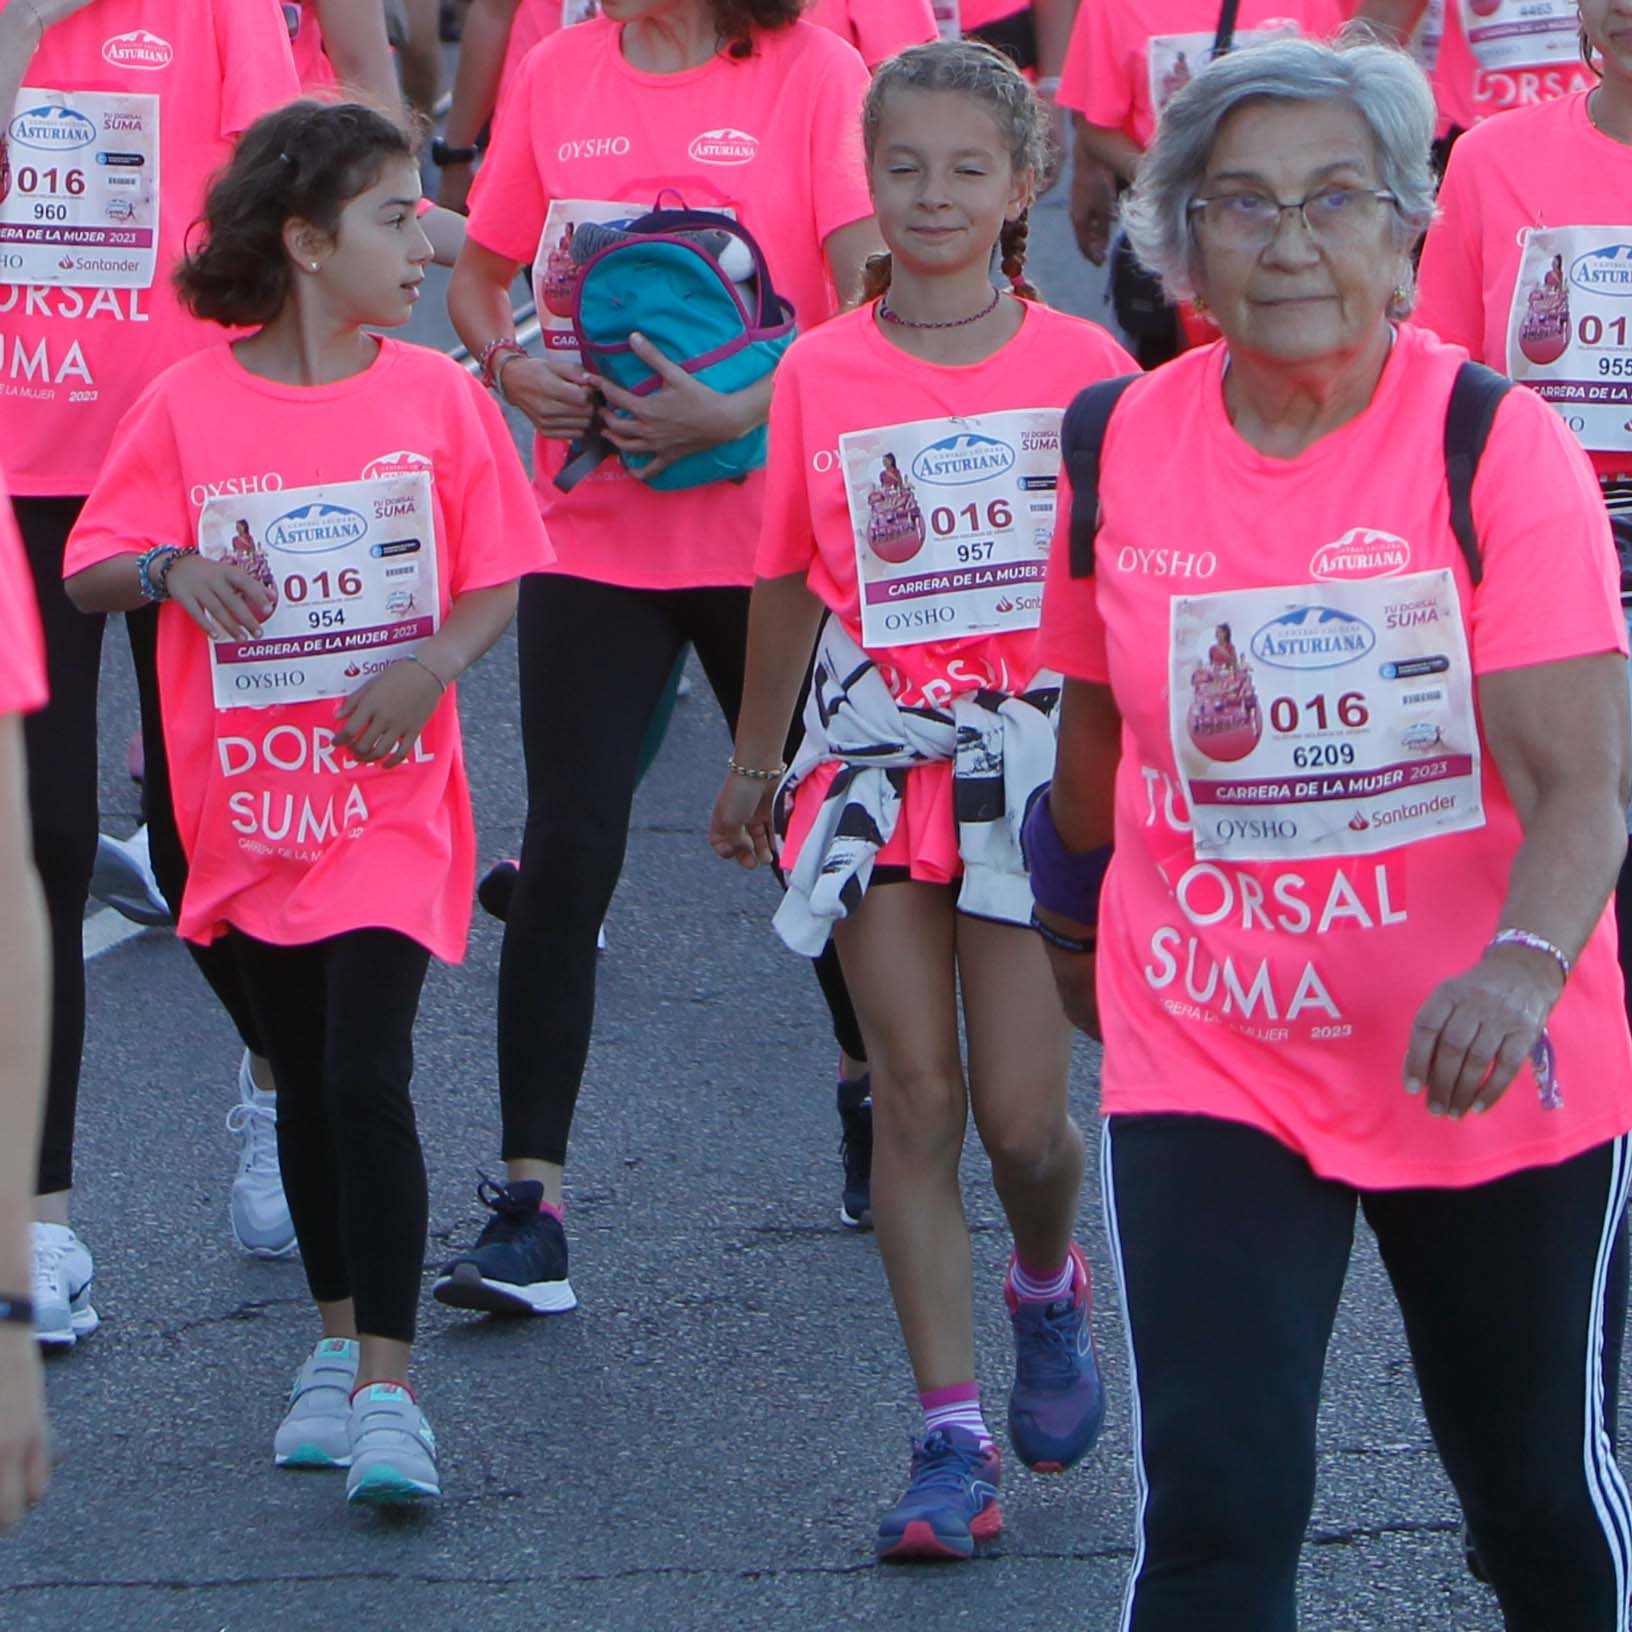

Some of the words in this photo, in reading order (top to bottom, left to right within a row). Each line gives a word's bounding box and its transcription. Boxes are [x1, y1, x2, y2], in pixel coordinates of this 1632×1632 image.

[106, 43, 169, 64] ASTURIANA
[16, 120, 89, 141] ASTURIANA
[104, 120, 143, 131] SUMA
[558, 136, 631, 162] OYSHO
[692, 143, 756, 158] ASTURIANA
[18, 167, 86, 195] 016
[34, 203, 68, 220] 960
[26, 229, 42, 240] DE
[45, 230, 61, 241] LA
[63, 231, 106, 243] MUJER
[109, 233, 137, 244] 2023
[76, 257, 140, 272] Santander
[69, 390, 99, 403] 2023
[1532, 385, 1586, 399] CARRERA
[1589, 387, 1608, 399] DE
[1611, 388, 1629, 400] LA
[1022, 439, 1059, 451] SUMA
[920, 453, 1009, 477] ASTURIANA
[375, 503, 416, 519] SUMA
[931, 499, 1013, 536] 016
[274, 522, 361, 545] ASTURIANA
[957, 542, 995, 562] 957
[1117, 546, 1217, 578] OYSHO
[1318, 550, 1404, 574] ASTURIANA
[284, 568, 362, 603] 016
[888, 577, 950, 596] CARRERA
[953, 573, 972, 586] DE
[975, 570, 993, 583] LA
[996, 566, 1038, 580] MUJER
[308, 608, 346, 629] 954
[885, 606, 956, 631] OYSHO
[1386, 607, 1440, 629] SUMA
[238, 640, 302, 659] CARRERA
[304, 638, 322, 651] DE
[325, 635, 343, 649] LA
[344, 630, 388, 646] MUJER
[392, 624, 418, 640] 2023
[1261, 633, 1366, 657] ASTURIANA
[234, 670, 306, 691] OYSHO
[1270, 691, 1369, 733] 016
[1293, 743, 1355, 768] 6209
[1215, 783, 1291, 801] CARRERA
[1295, 782, 1318, 797] DE
[1323, 778, 1344, 794] LA
[1348, 769, 1404, 792] MUJER
[1410, 761, 1448, 781] 2023
[229, 783, 369, 844] SUMA
[1372, 795, 1457, 829] Santander
[1216, 819, 1297, 841] OYSHO
[1159, 863, 1408, 934] ORSAL
[1144, 926, 1342, 1021] SUMA
[1311, 1024, 1353, 1040] 2023
